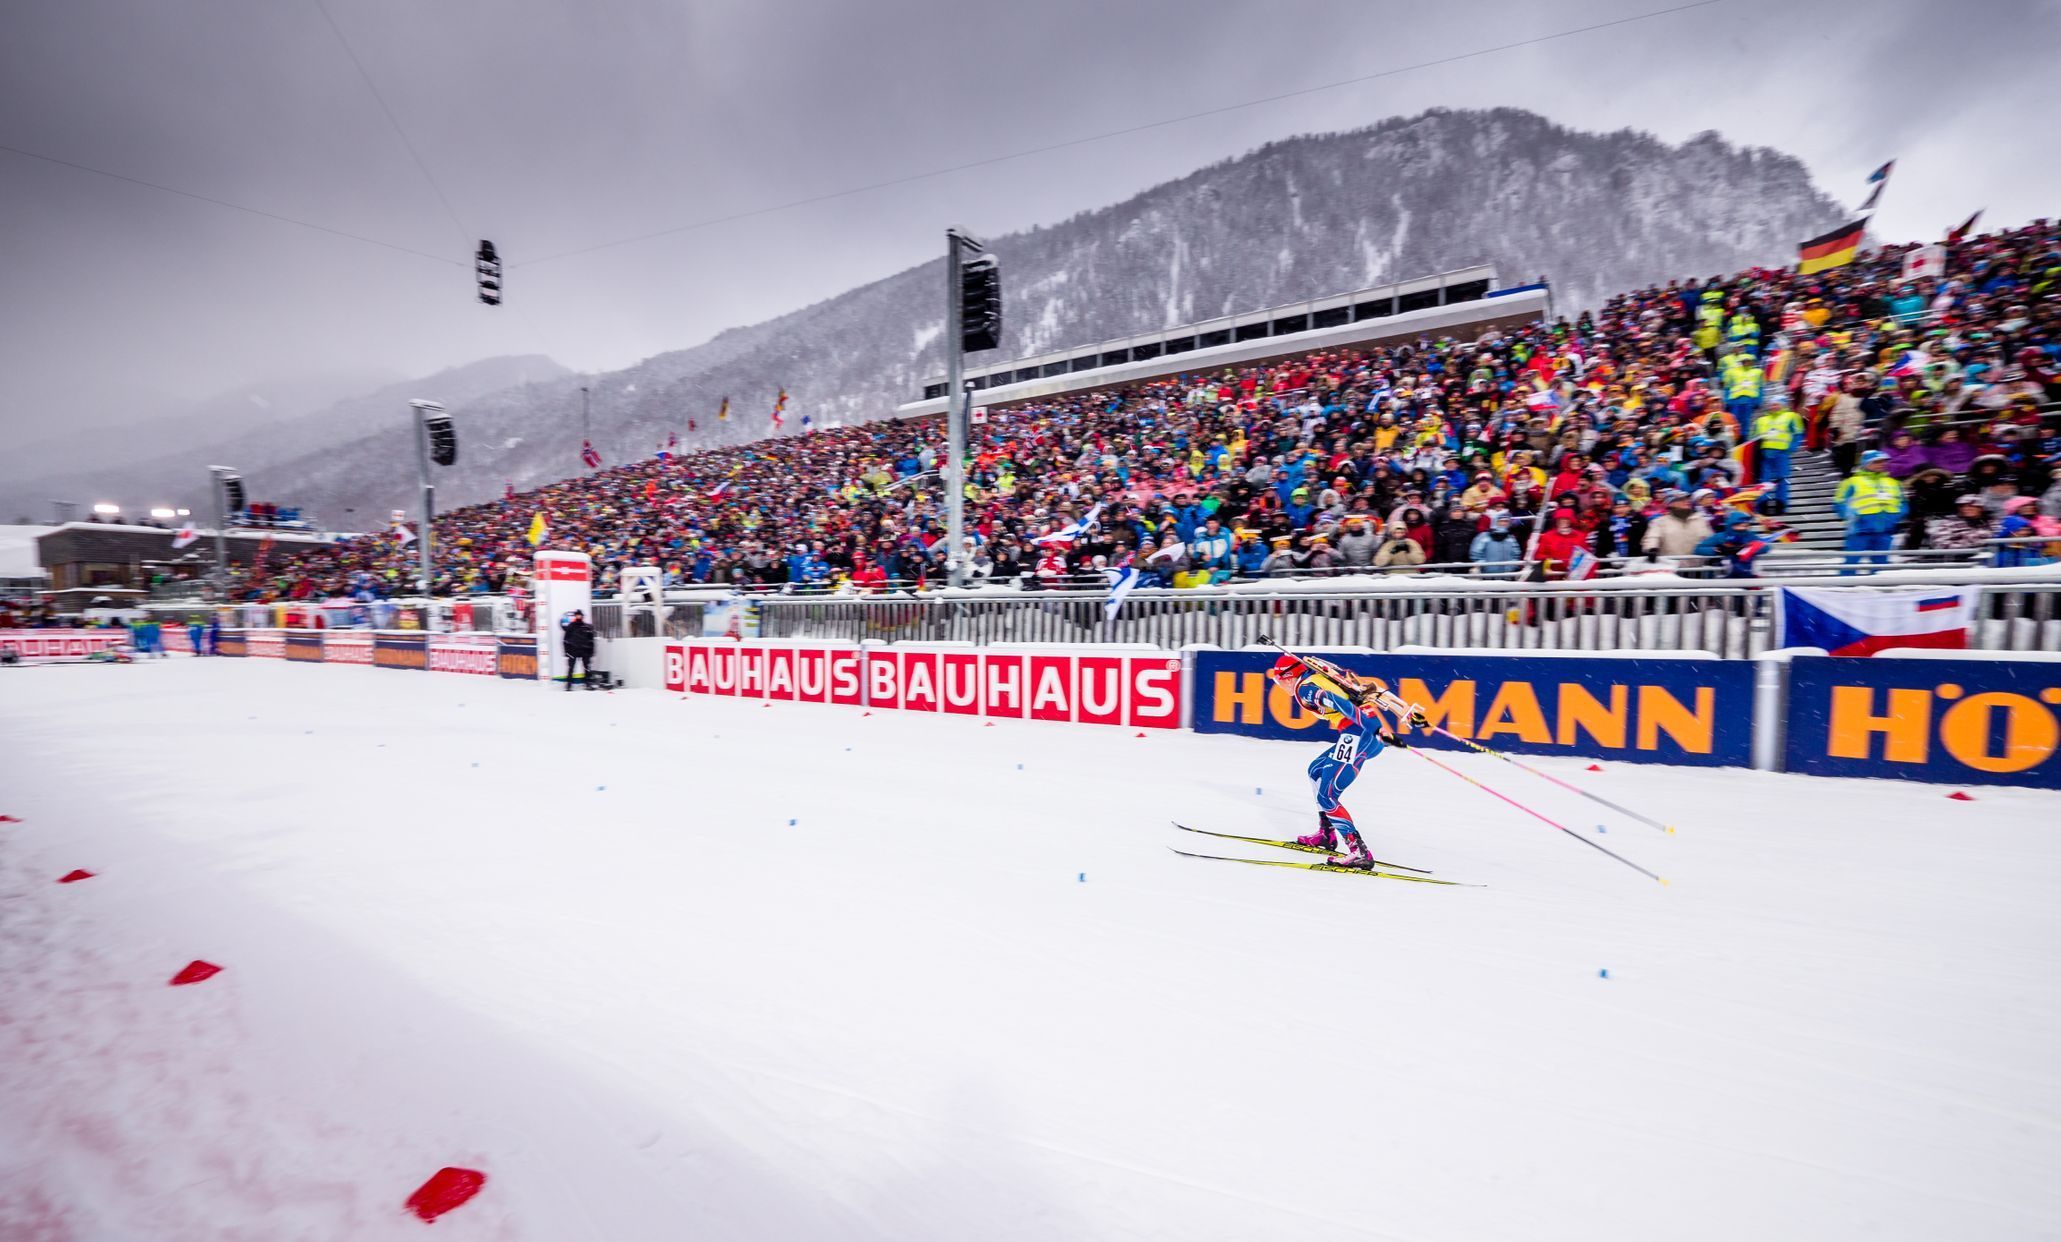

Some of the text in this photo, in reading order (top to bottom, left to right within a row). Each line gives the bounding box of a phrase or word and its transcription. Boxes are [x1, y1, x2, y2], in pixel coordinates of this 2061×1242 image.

[666, 652, 859, 696] BAUHAUS
[869, 652, 1175, 717] BAUHAUS
[1336, 744, 1353, 762] 64
